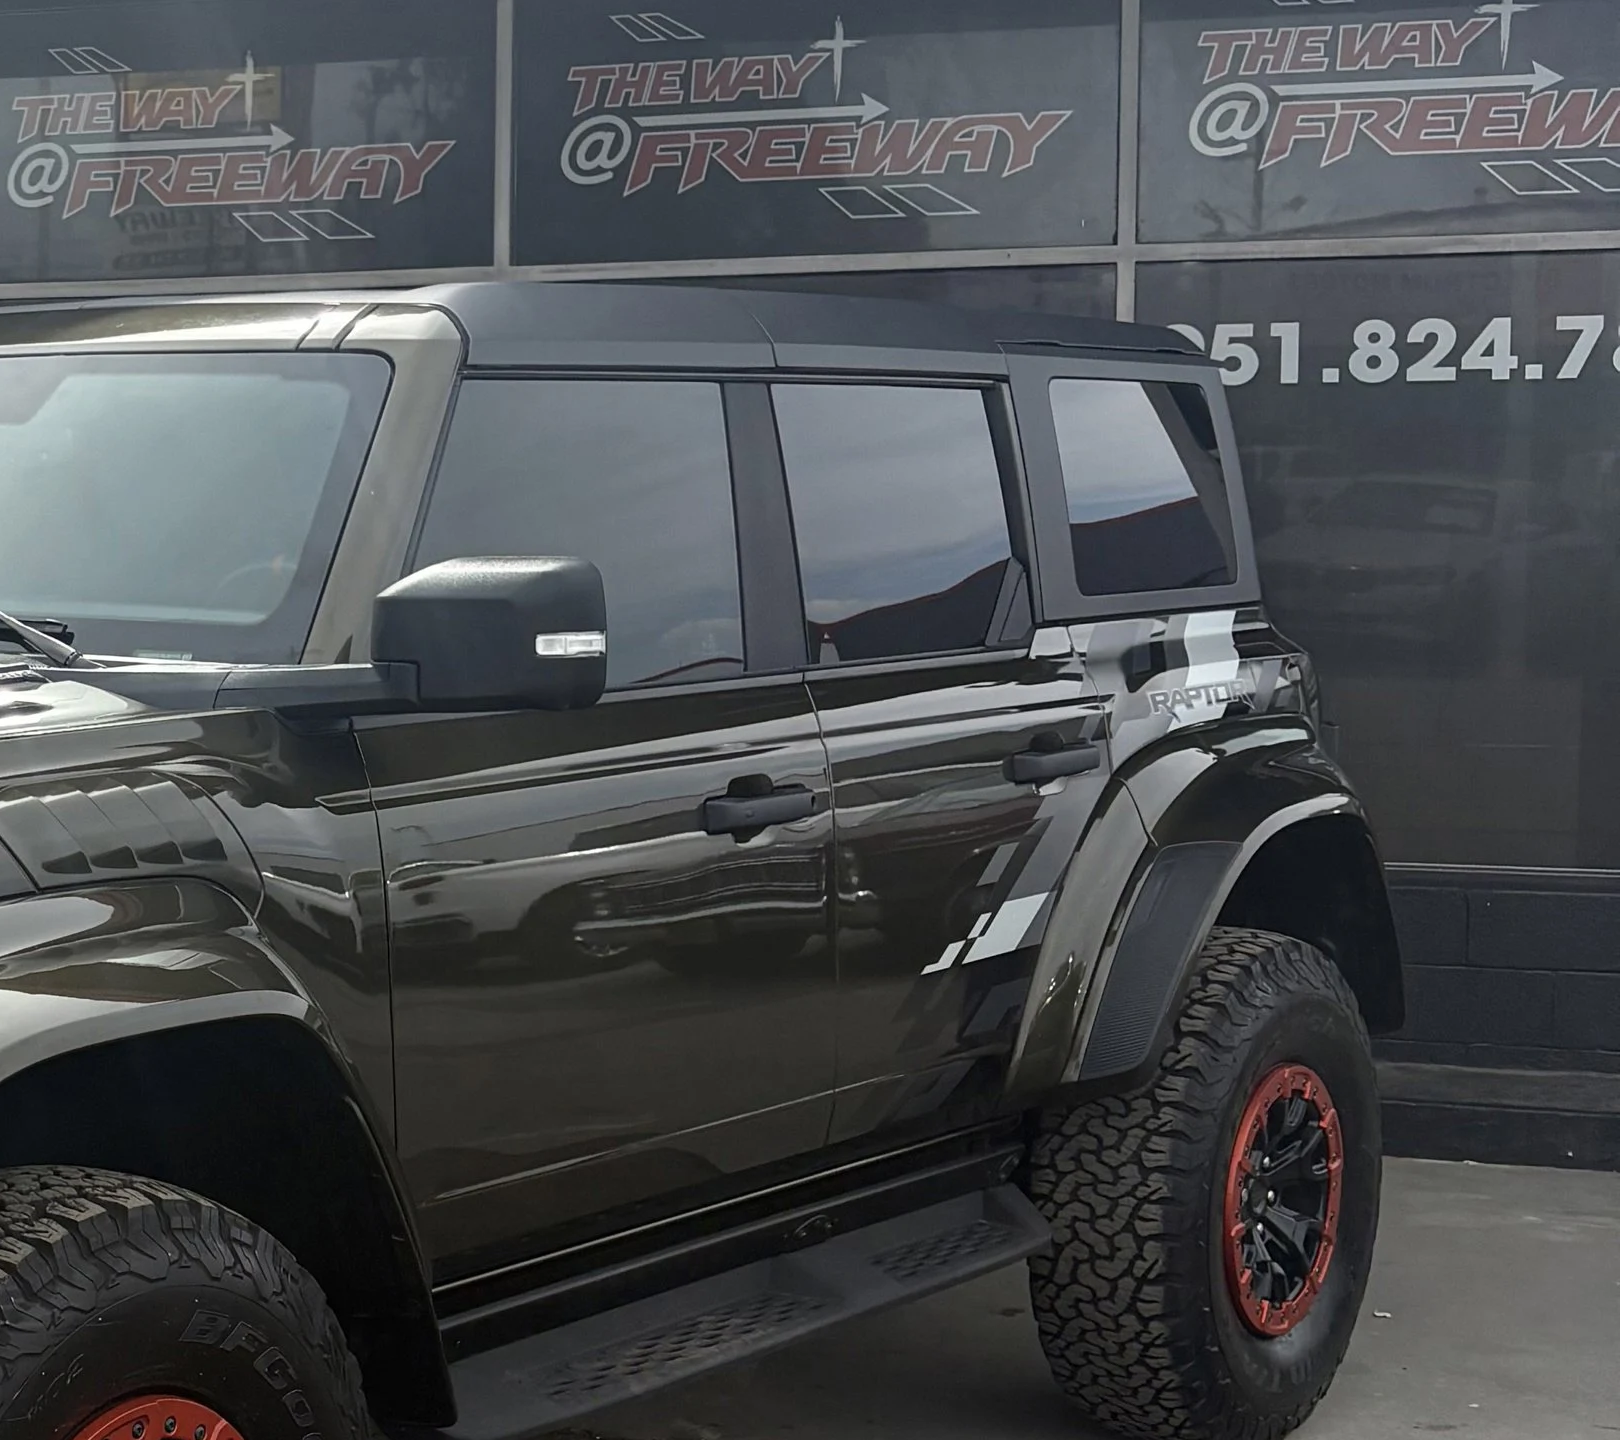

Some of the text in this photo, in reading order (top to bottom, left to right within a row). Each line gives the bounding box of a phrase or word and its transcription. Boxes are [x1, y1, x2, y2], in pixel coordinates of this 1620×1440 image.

[566, 51, 833, 118] THE WAY
[1196, 15, 1500, 86] THE WAY
[11, 84, 245, 144] THE WAY
[1187, 81, 1620, 171] @FREEW
[6, 139, 458, 220] @FREEWAY
[560, 109, 1074, 197] @FREEWAY
[1166, 314, 1620, 387] 51.824.7
[1147, 679, 1256, 723] RAPTOR
